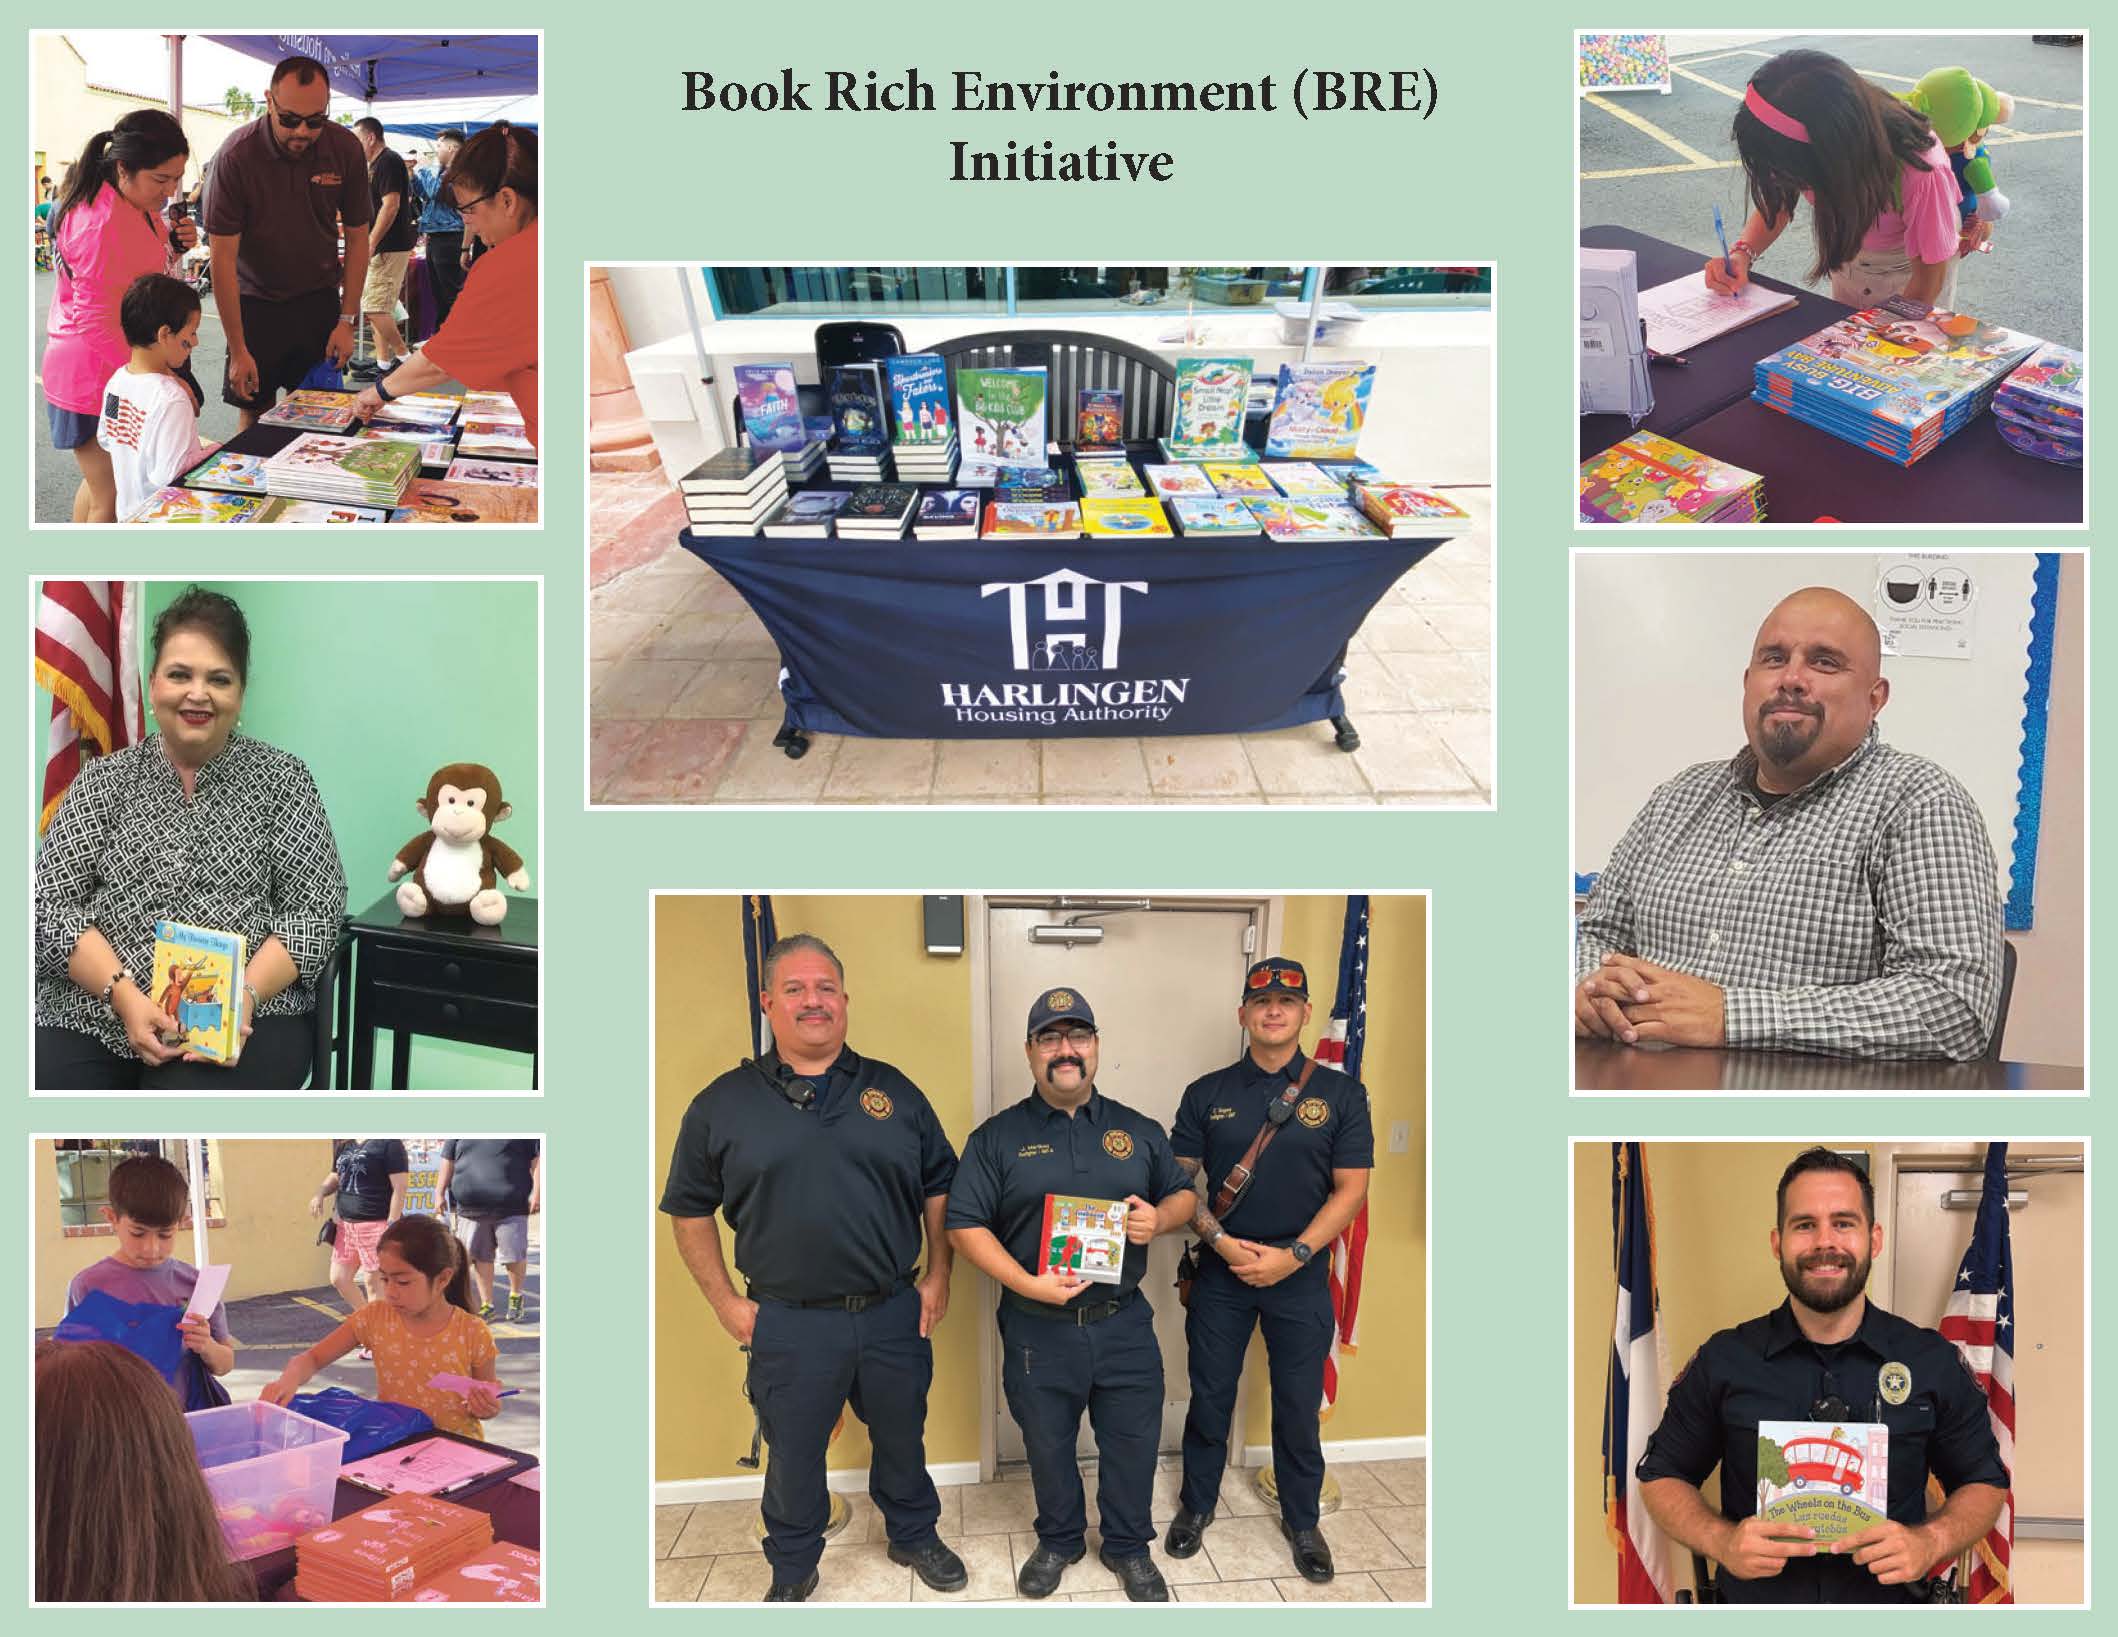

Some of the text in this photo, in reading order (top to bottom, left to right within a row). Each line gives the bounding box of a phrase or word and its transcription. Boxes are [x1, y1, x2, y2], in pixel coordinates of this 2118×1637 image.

[1784, 361, 1829, 379] BUSY
[1813, 360, 1902, 394] ADVENTURE
[760, 399, 788, 417] FAITH
[940, 678, 1191, 707] HARLINGEN
[956, 705, 1173, 725] Housing Authority
[407, 1171, 440, 1188] ESH
[1768, 1498, 1872, 1522] The Wheels on the Bus
